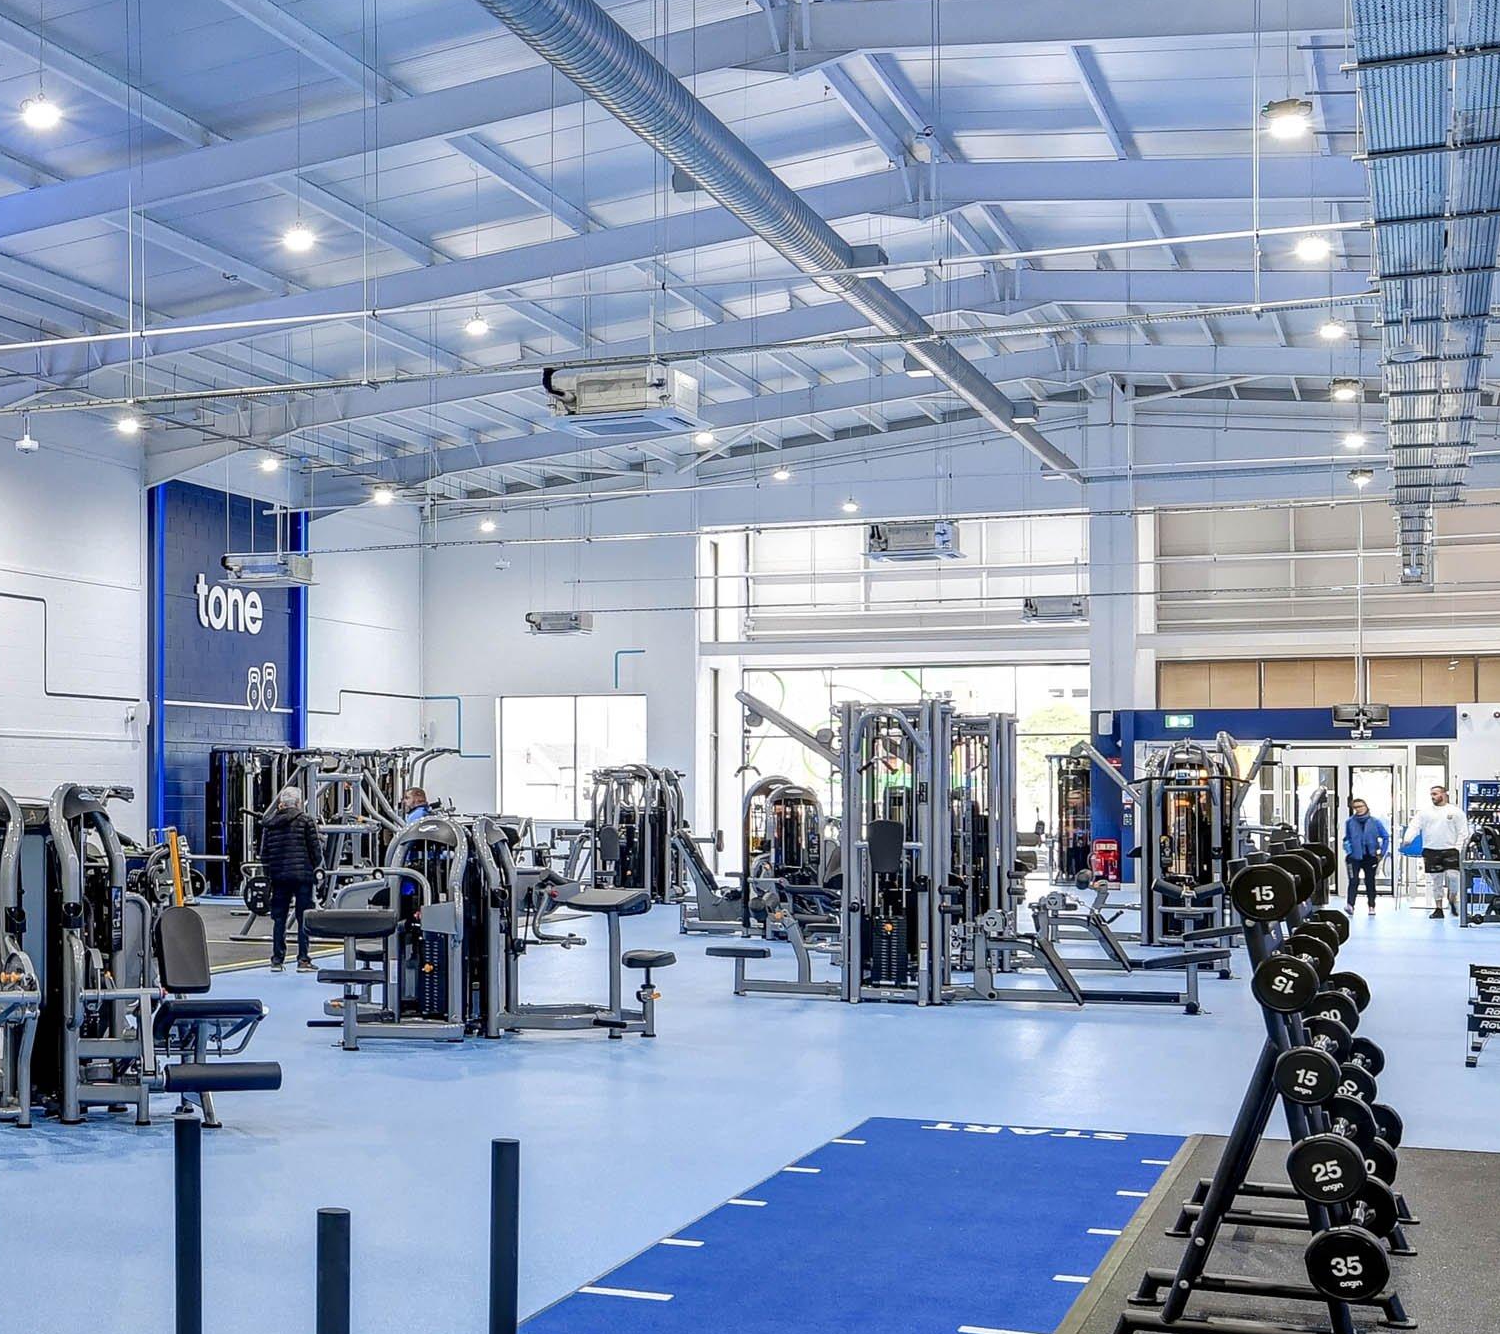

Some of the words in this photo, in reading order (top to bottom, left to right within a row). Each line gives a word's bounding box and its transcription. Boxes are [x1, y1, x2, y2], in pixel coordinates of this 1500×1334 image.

[196, 573, 263, 635] tone
[1251, 885, 1275, 902] 15
[1271, 976, 1295, 995] 15
[1295, 1068, 1319, 1087] 15
[920, 1123, 1129, 1141] START
[1311, 1160, 1343, 1183] 25
[1330, 1255, 1364, 1277] 35
